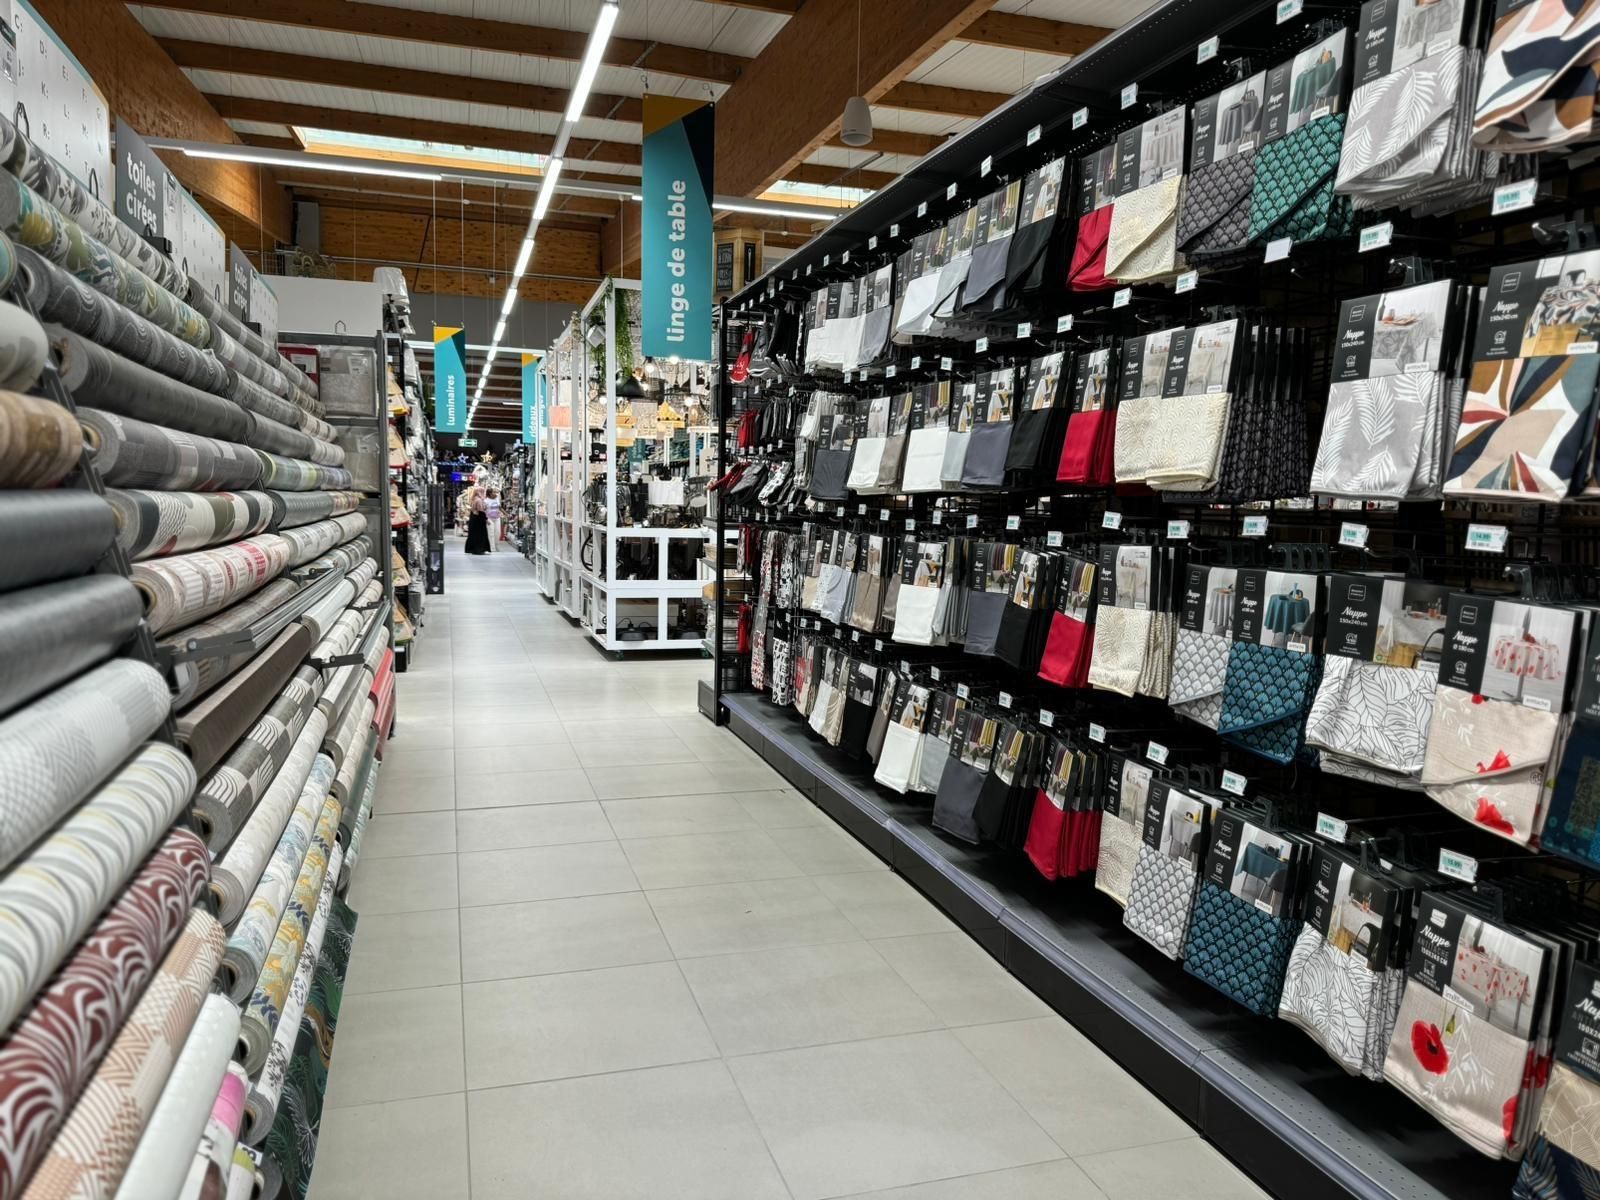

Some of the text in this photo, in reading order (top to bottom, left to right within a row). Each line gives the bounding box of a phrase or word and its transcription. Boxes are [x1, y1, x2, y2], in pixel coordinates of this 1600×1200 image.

[127, 152, 156, 201] toiles
[126, 189, 157, 234] cirées
[666, 179, 690, 342] linge de table
[1491, 300, 1519, 313] Nappe
[1342, 329, 1365, 341] Nappe
[446, 374, 455, 427] luminaires
[1341, 606, 1368, 619] Nappe
[1452, 630, 1478, 645] Nappe
[1420, 925, 1451, 948] Nappe
